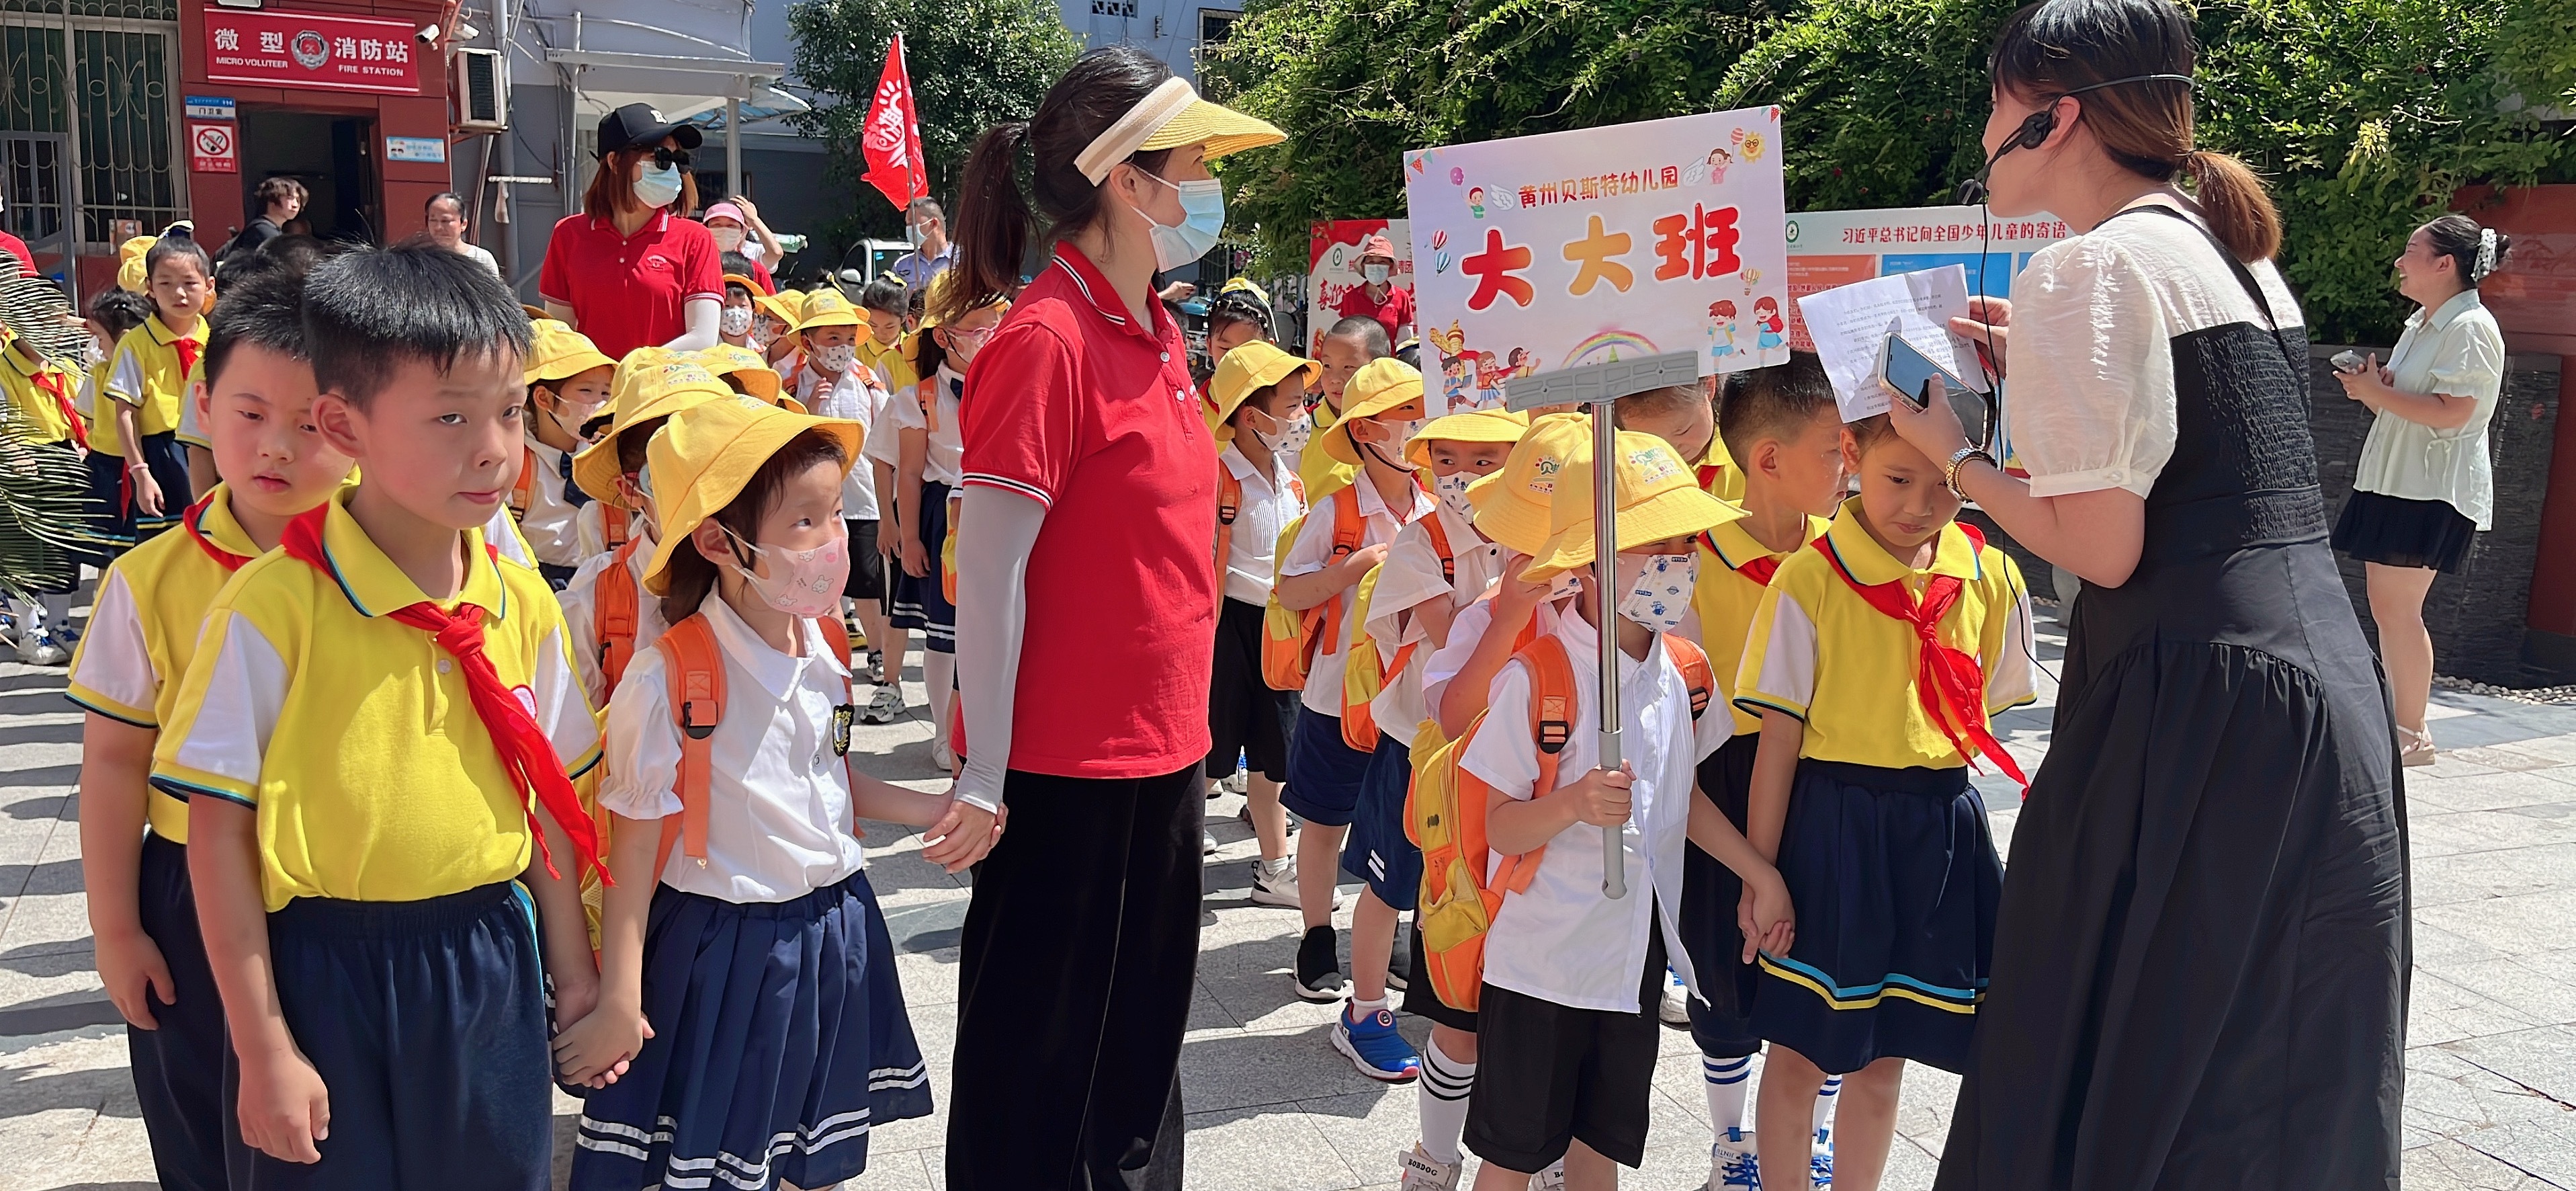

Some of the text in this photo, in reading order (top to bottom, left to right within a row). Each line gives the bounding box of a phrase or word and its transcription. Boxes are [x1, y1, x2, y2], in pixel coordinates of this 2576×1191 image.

[334, 36, 409, 63] 消防站
[216, 56, 288, 69] MICRO VOLUTEER
[338, 64, 404, 77] FIRE STATION
[1518, 166, 1678, 209] 黄州贝斯特幼儿园
[1842, 221, 2067, 244] 习近平总书记向全国少年儿童的寄语
[1461, 202, 1741, 311] 大大班
[1408, 1158, 1438, 1176] BOBDOG
